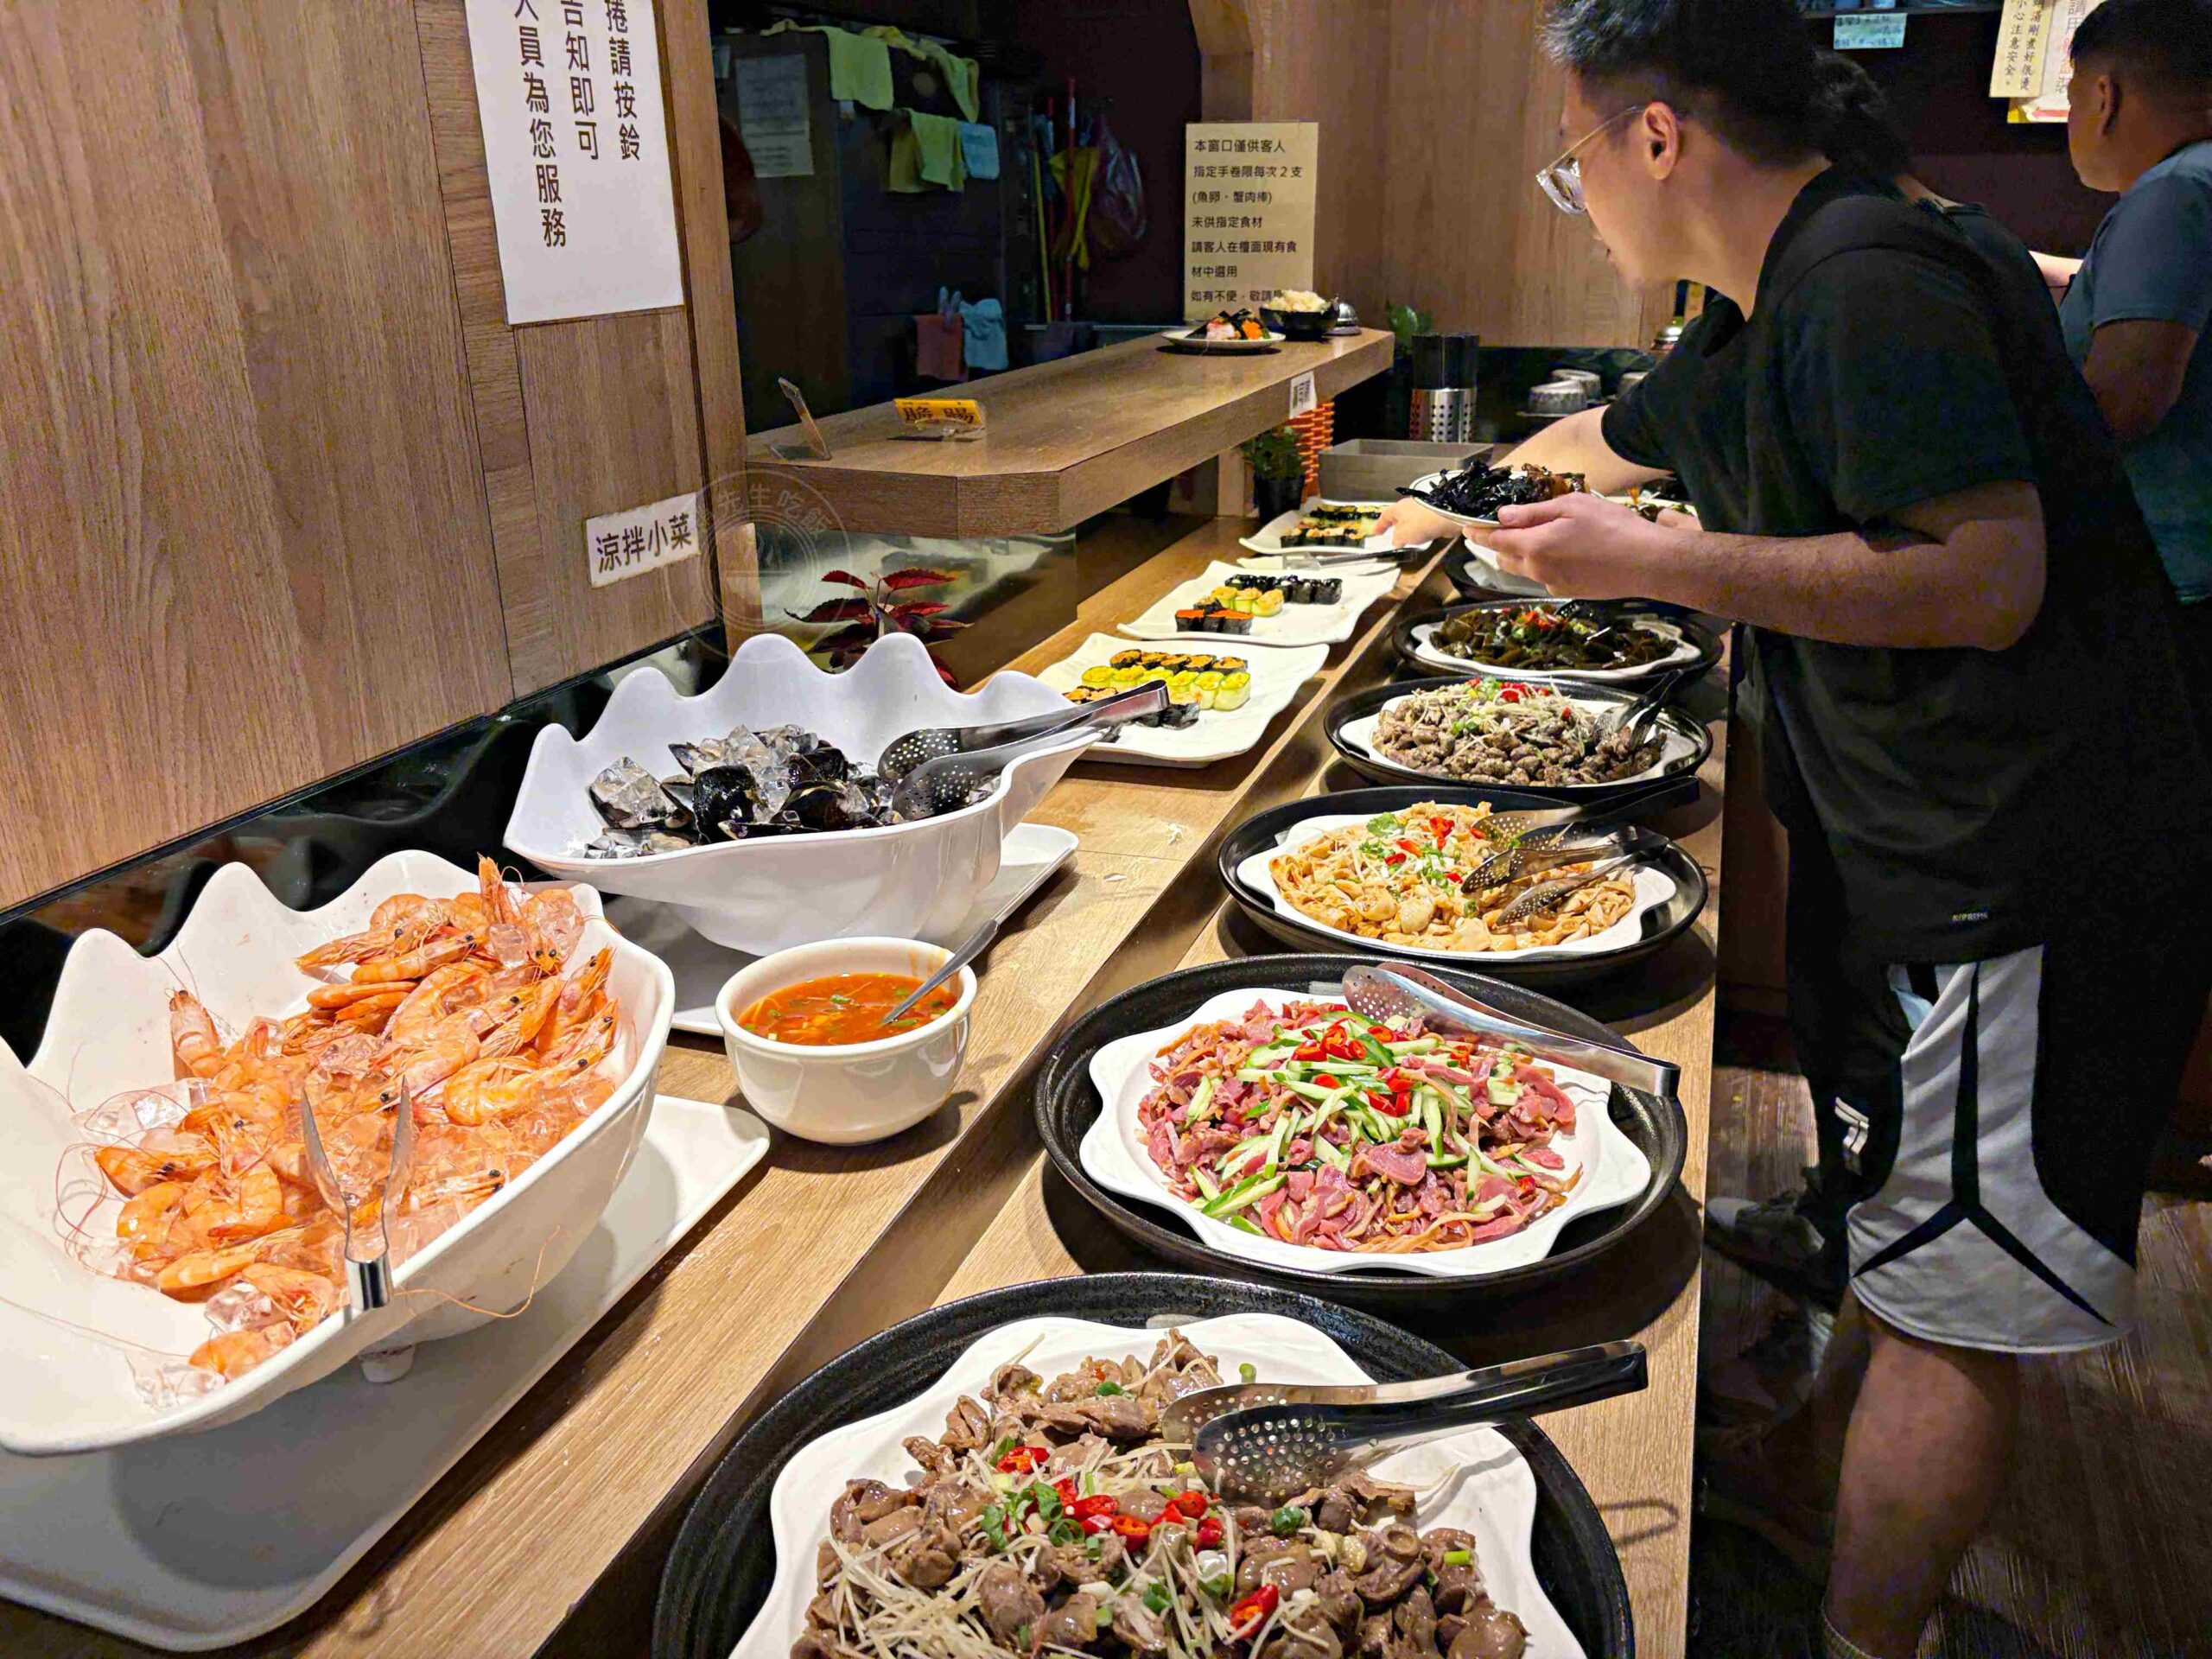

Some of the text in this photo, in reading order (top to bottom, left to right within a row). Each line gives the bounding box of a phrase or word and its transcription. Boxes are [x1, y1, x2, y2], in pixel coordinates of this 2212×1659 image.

[561, 0, 600, 160] 告知即可
[606, 0, 639, 161] 捲請按鈴
[1194, 139, 1286, 153] 本窗口僅供客人
[596, 512, 693, 574] 涼拌小菜
